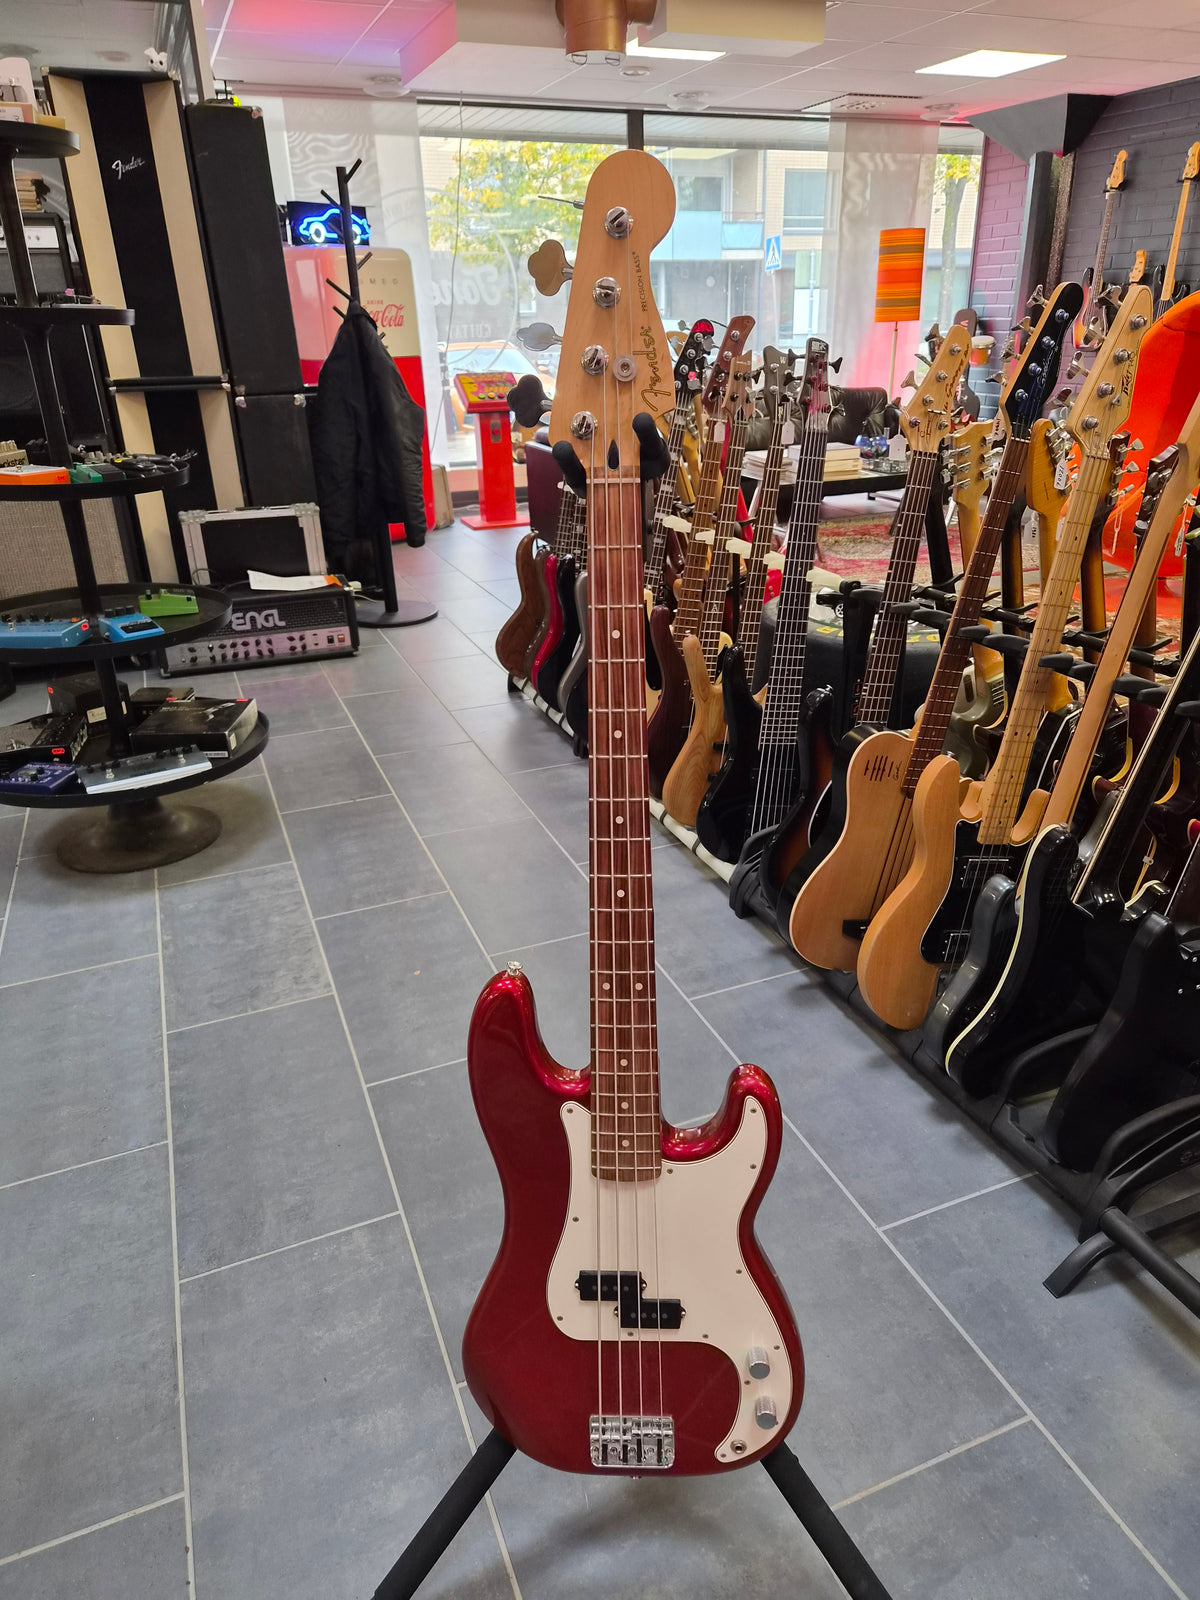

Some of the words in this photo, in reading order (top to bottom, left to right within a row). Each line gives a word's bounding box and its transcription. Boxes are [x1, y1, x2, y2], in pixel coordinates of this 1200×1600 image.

[637, 274, 648, 312] PRECISION
[632, 326, 672, 412] Fender
[231, 609, 286, 631] ENGL
